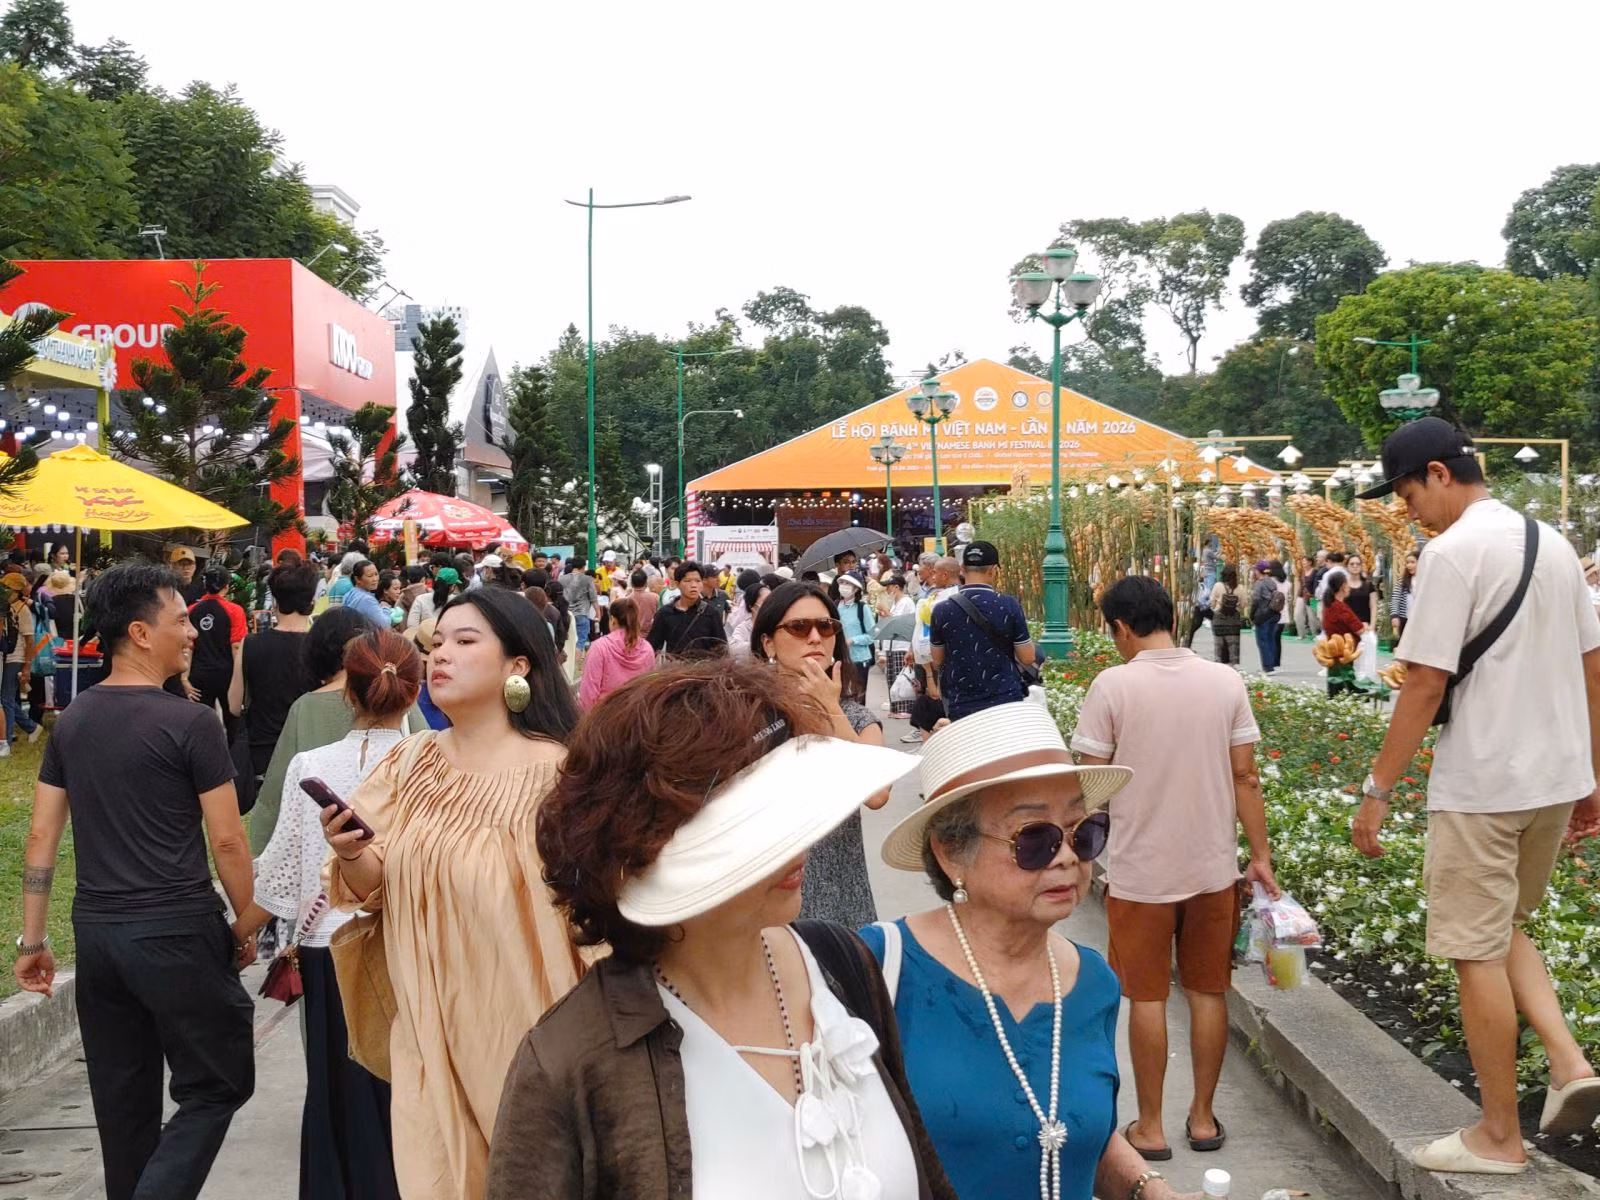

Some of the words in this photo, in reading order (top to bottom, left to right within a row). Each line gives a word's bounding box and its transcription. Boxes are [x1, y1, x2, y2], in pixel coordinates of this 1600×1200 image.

[831, 420, 848, 438] LỄ
[851, 422, 876, 440] HỘI
[880, 420, 918, 437] BÁNH
[943, 420, 971, 438] VIỆT
[974, 421, 1007, 435] NAM
[1021, 416, 1048, 435] LẦN
[1065, 418, 1098, 434] NĂM
[1102, 421, 1137, 434] 2026
[1010, 440, 1046, 449] FESTIVAL
